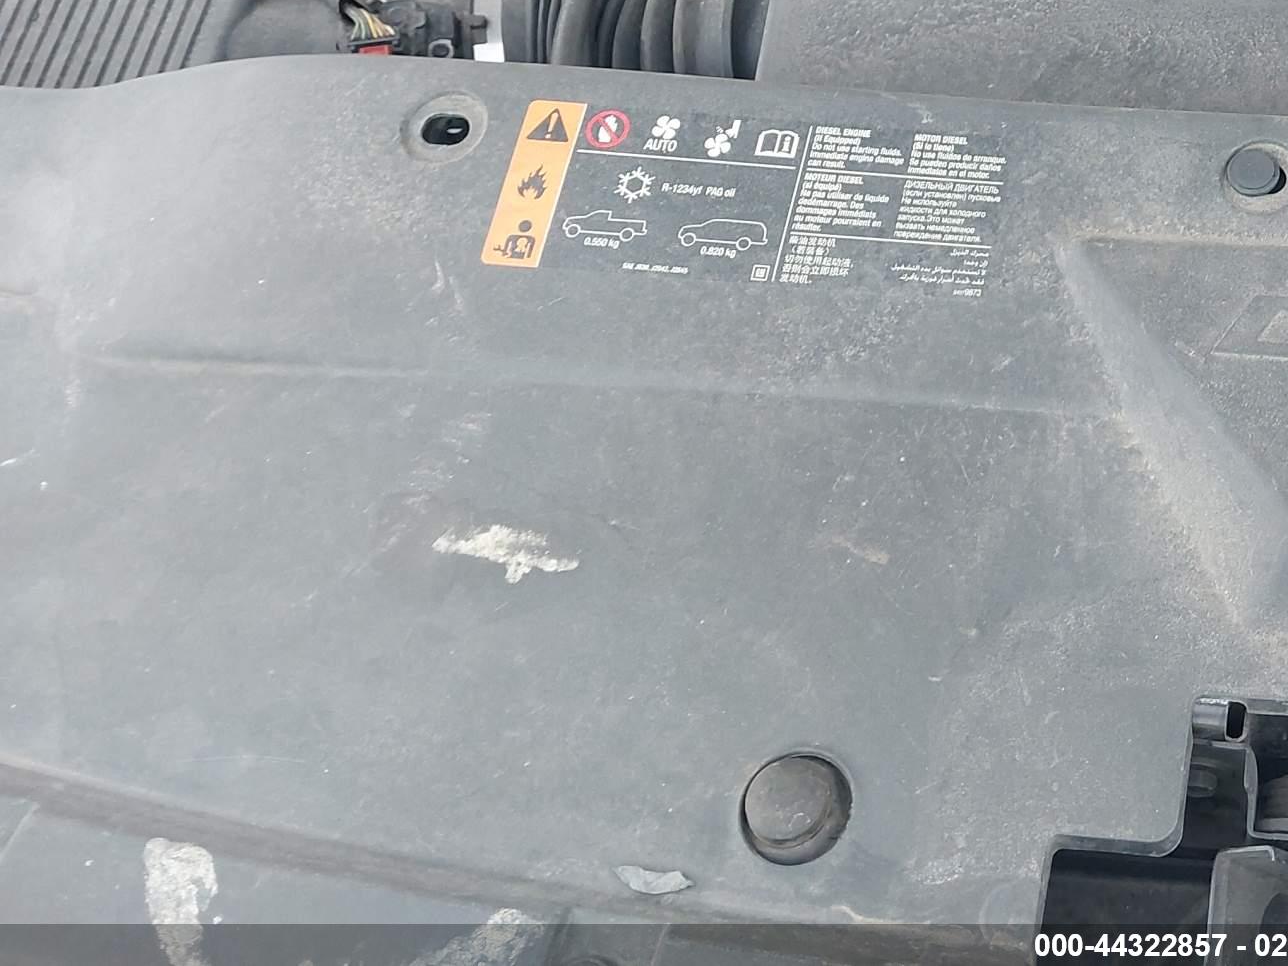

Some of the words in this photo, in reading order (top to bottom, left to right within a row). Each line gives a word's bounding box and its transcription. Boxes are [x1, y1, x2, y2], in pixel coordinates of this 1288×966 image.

[816, 126, 841, 135] DIESEL
[843, 128, 872, 138] ENGINE
[824, 136, 861, 146] Equipped)
[914, 134, 941, 142] MOTOR
[942, 135, 968, 144] DIESEL
[643, 138, 678, 154] AUTO
[851, 145, 879, 155] starting
[810, 151, 848, 160] Immediate
[849, 154, 874, 163] engine
[875, 155, 904, 166] damage
[822, 160, 845, 168] result.
[920, 159, 947, 167] pueden
[948, 162, 978, 170] producir
[804, 172, 836, 182] MOTEUR
[837, 175, 864, 184] DIESEL
[662, 183, 703, 196] R-1234yf
[706, 185, 723, 197] PAG
[724, 187, 736, 197] oil
[609, 238, 620, 249] kg
[701, 247, 723, 256] 0.820
[725, 248, 737, 258] kg
